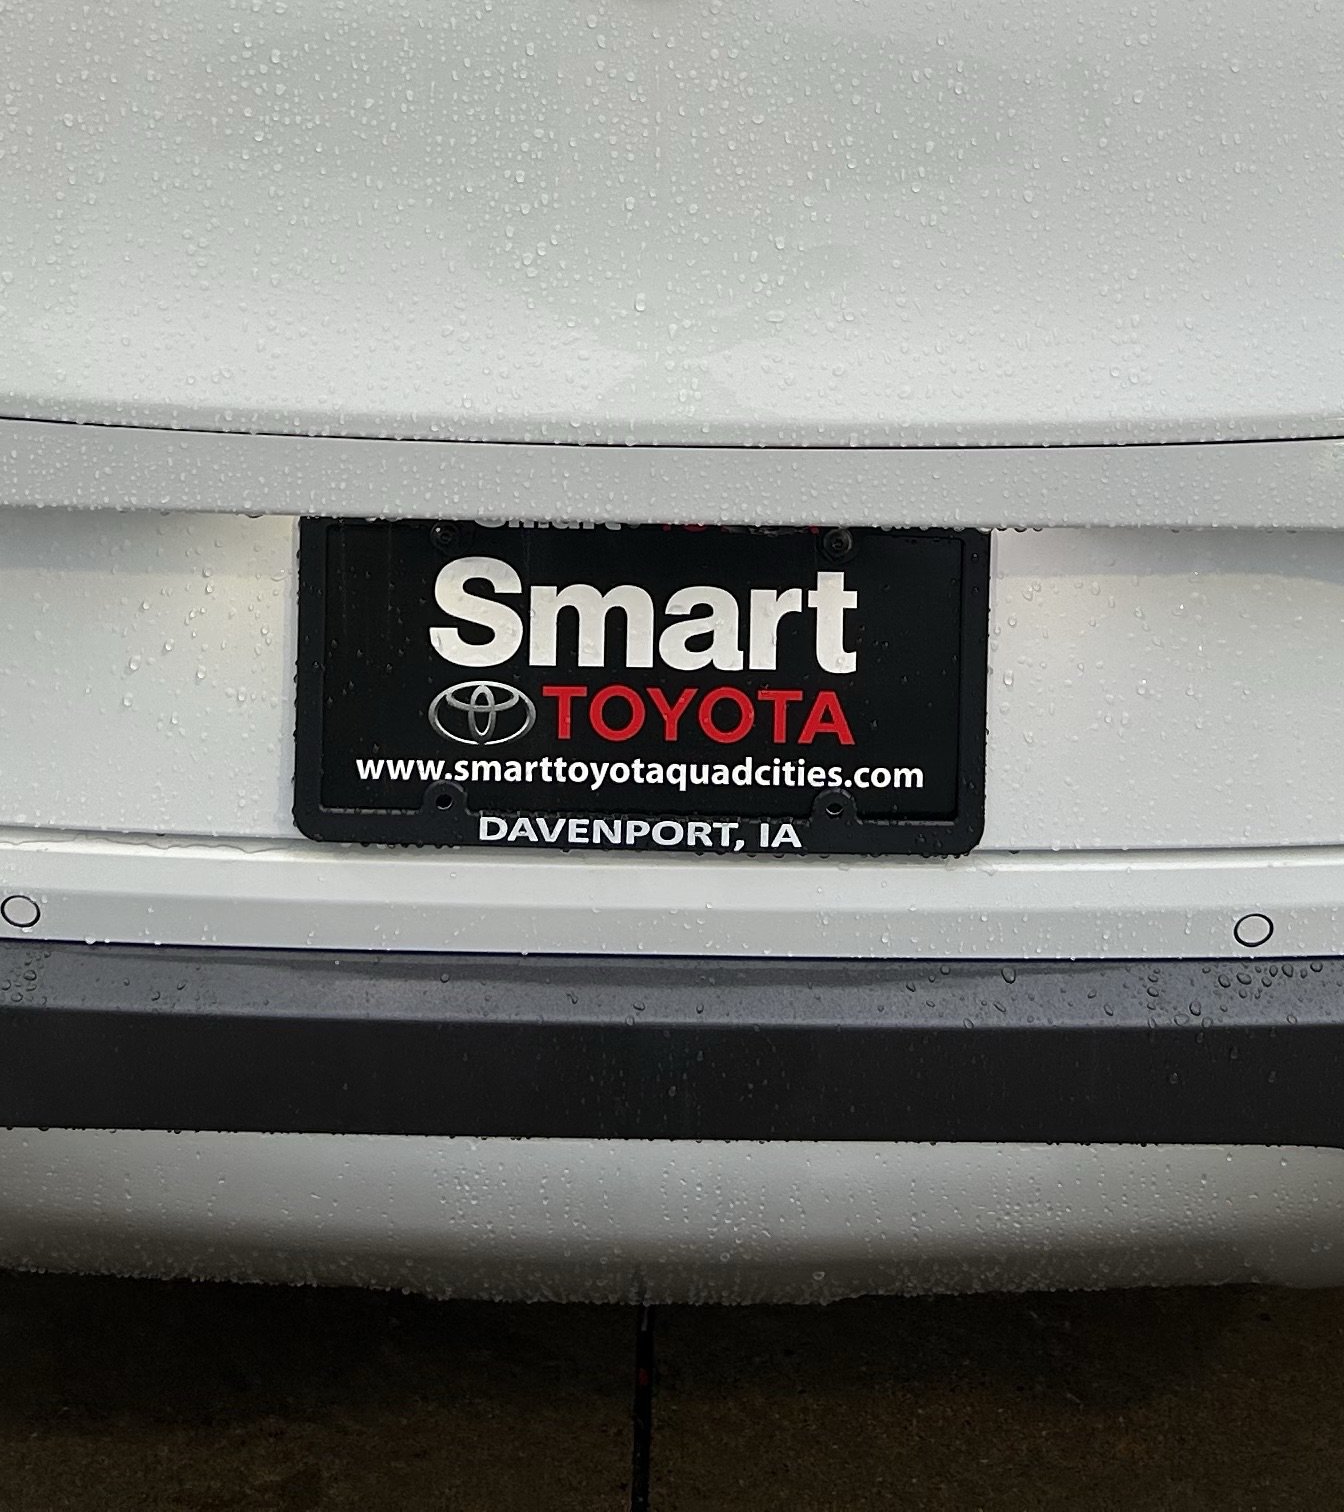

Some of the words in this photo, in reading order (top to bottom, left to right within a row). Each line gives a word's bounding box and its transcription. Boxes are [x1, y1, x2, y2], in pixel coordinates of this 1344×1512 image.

[428, 555, 859, 675] Smart
[542, 683, 855, 745] TOYOTA
[354, 755, 925, 792] www.smarttoyotaquadcities.com
[478, 815, 746, 852] DAVENPORT,
[758, 822, 804, 849] IA
